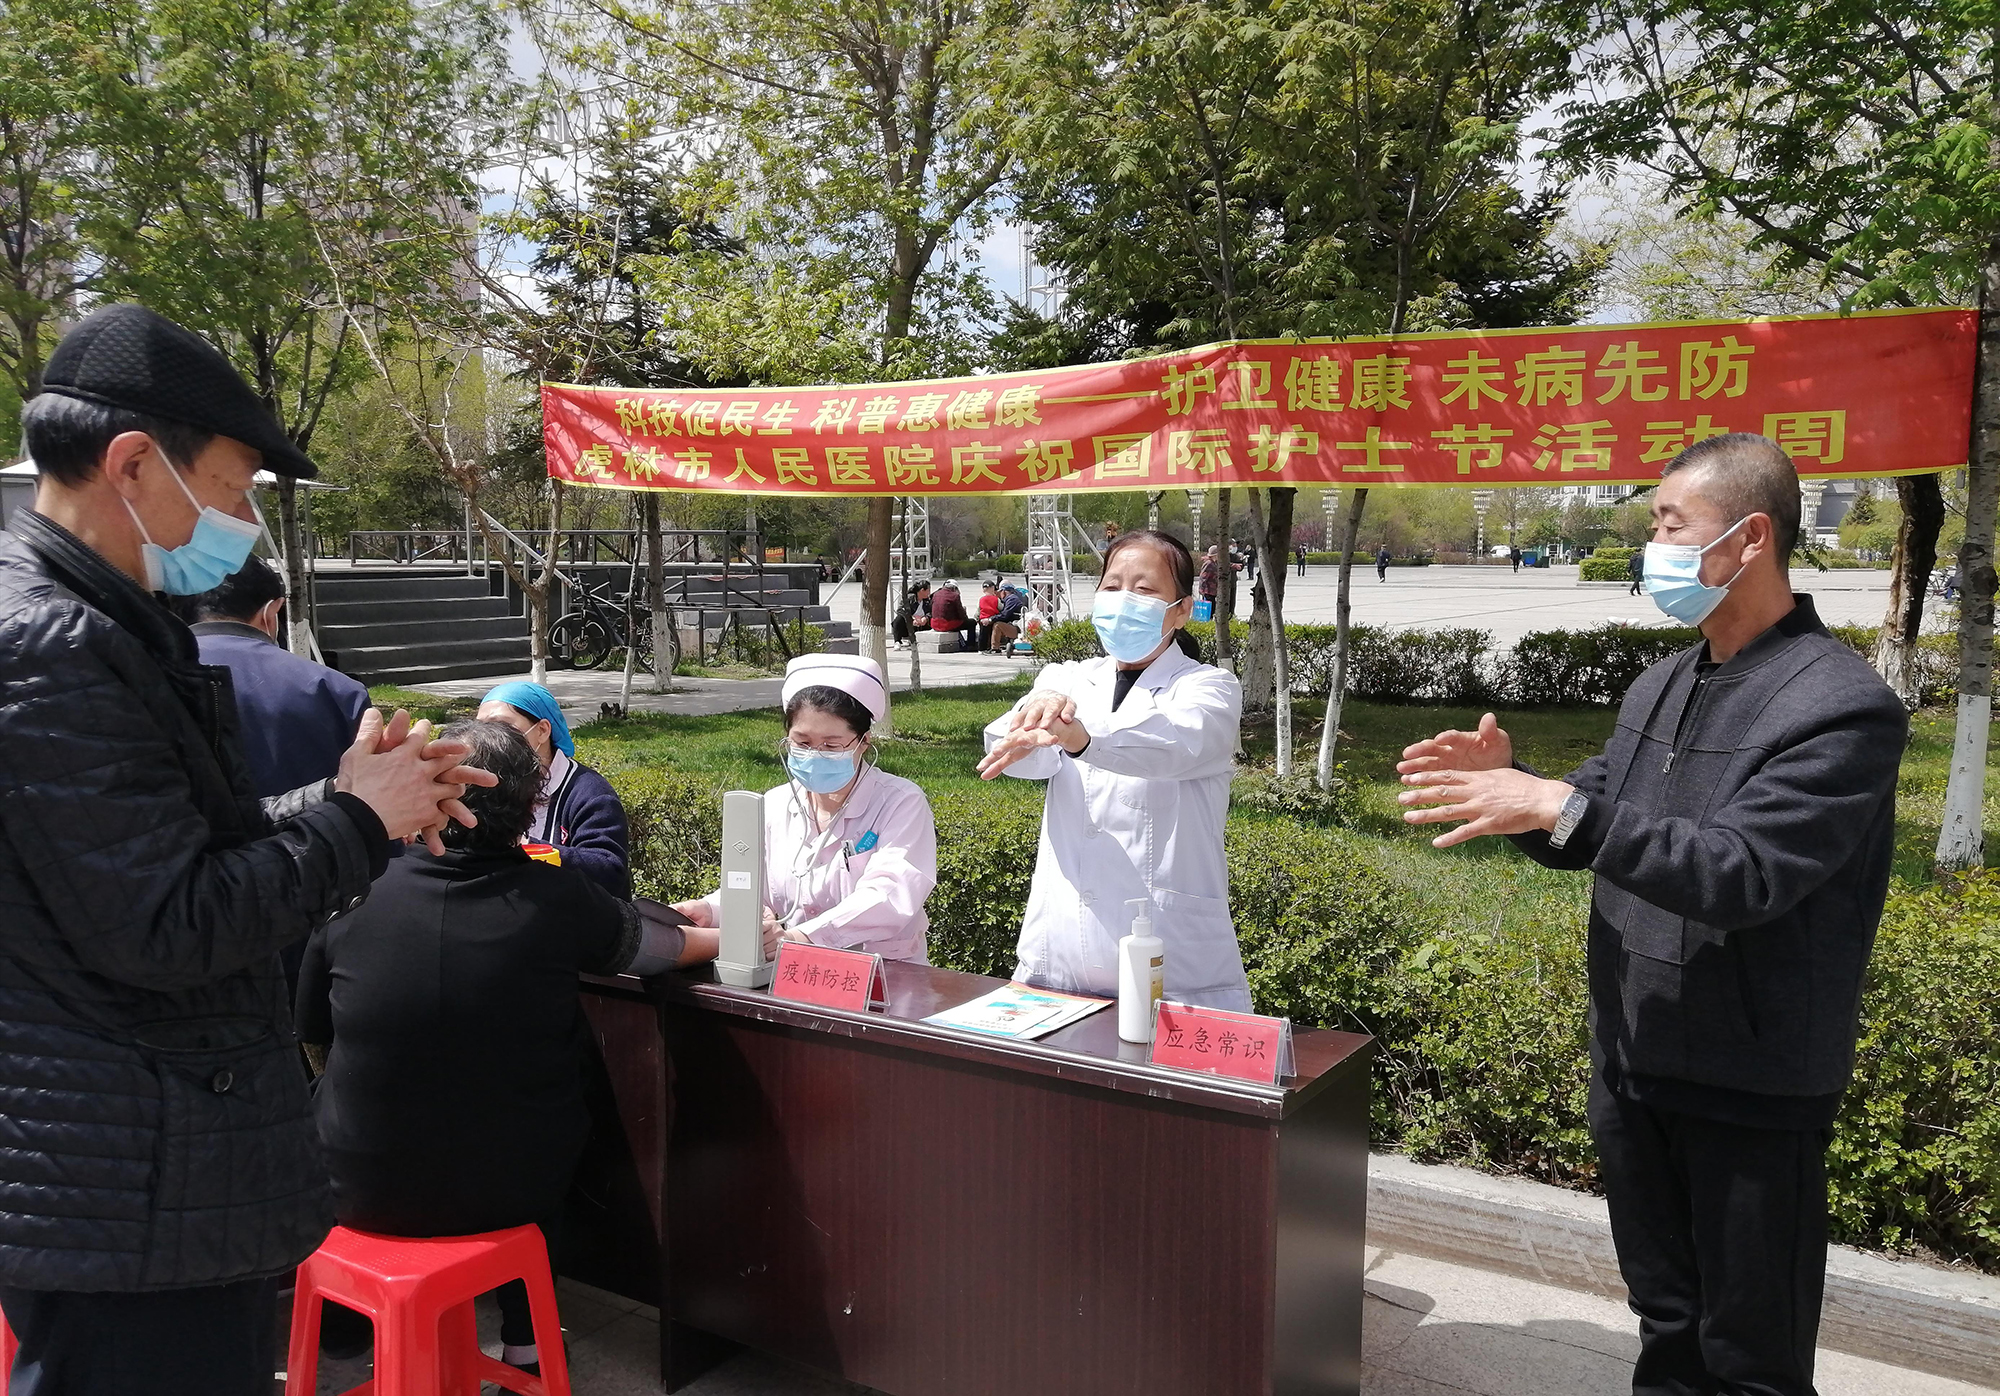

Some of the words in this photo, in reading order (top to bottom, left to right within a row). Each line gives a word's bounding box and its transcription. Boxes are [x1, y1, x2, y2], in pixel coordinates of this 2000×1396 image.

[615, 397, 799, 436] 科技促民生
[1441, 336, 1755, 409] 未病先防
[783, 962, 860, 992] 疫情防控
[1164, 1024, 1266, 1060] 应急常识
